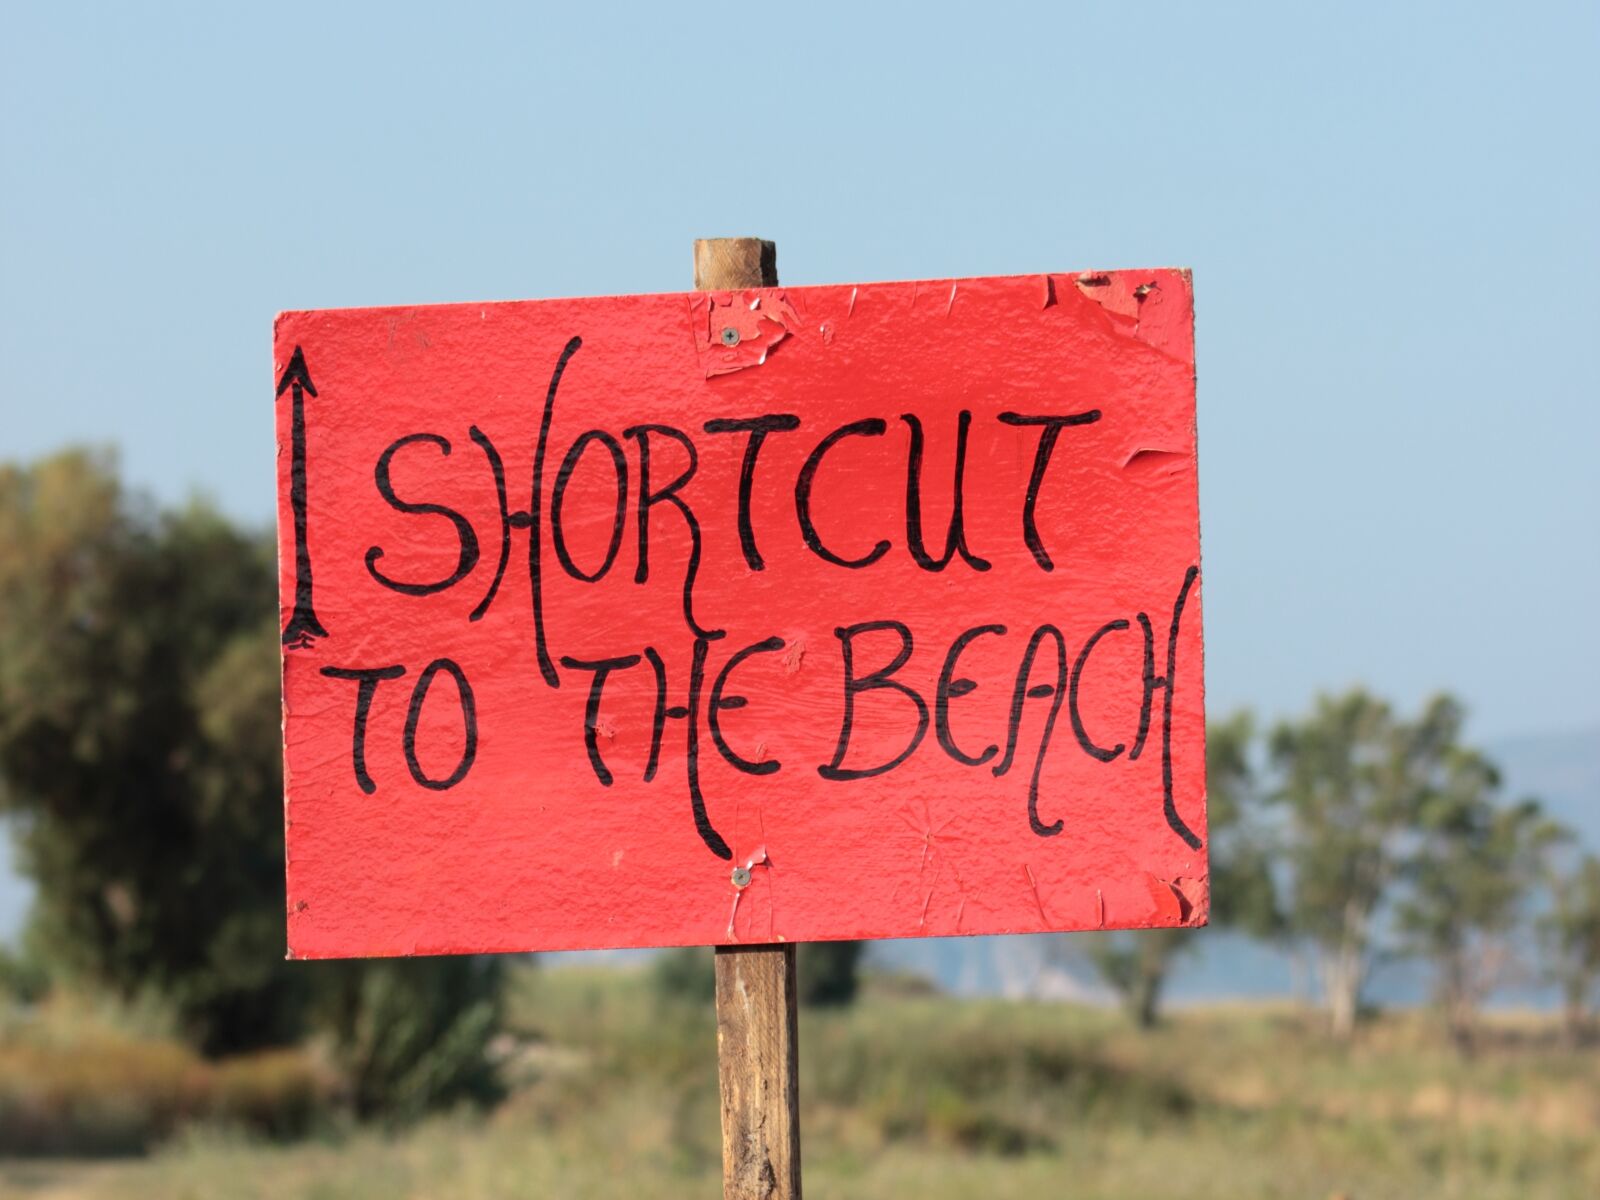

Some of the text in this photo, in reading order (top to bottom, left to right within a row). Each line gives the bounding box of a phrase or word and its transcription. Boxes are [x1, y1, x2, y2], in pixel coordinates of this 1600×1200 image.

[365, 336, 1102, 688] SHORTCUT
[320, 566, 1201, 860] TO THE BEACH
